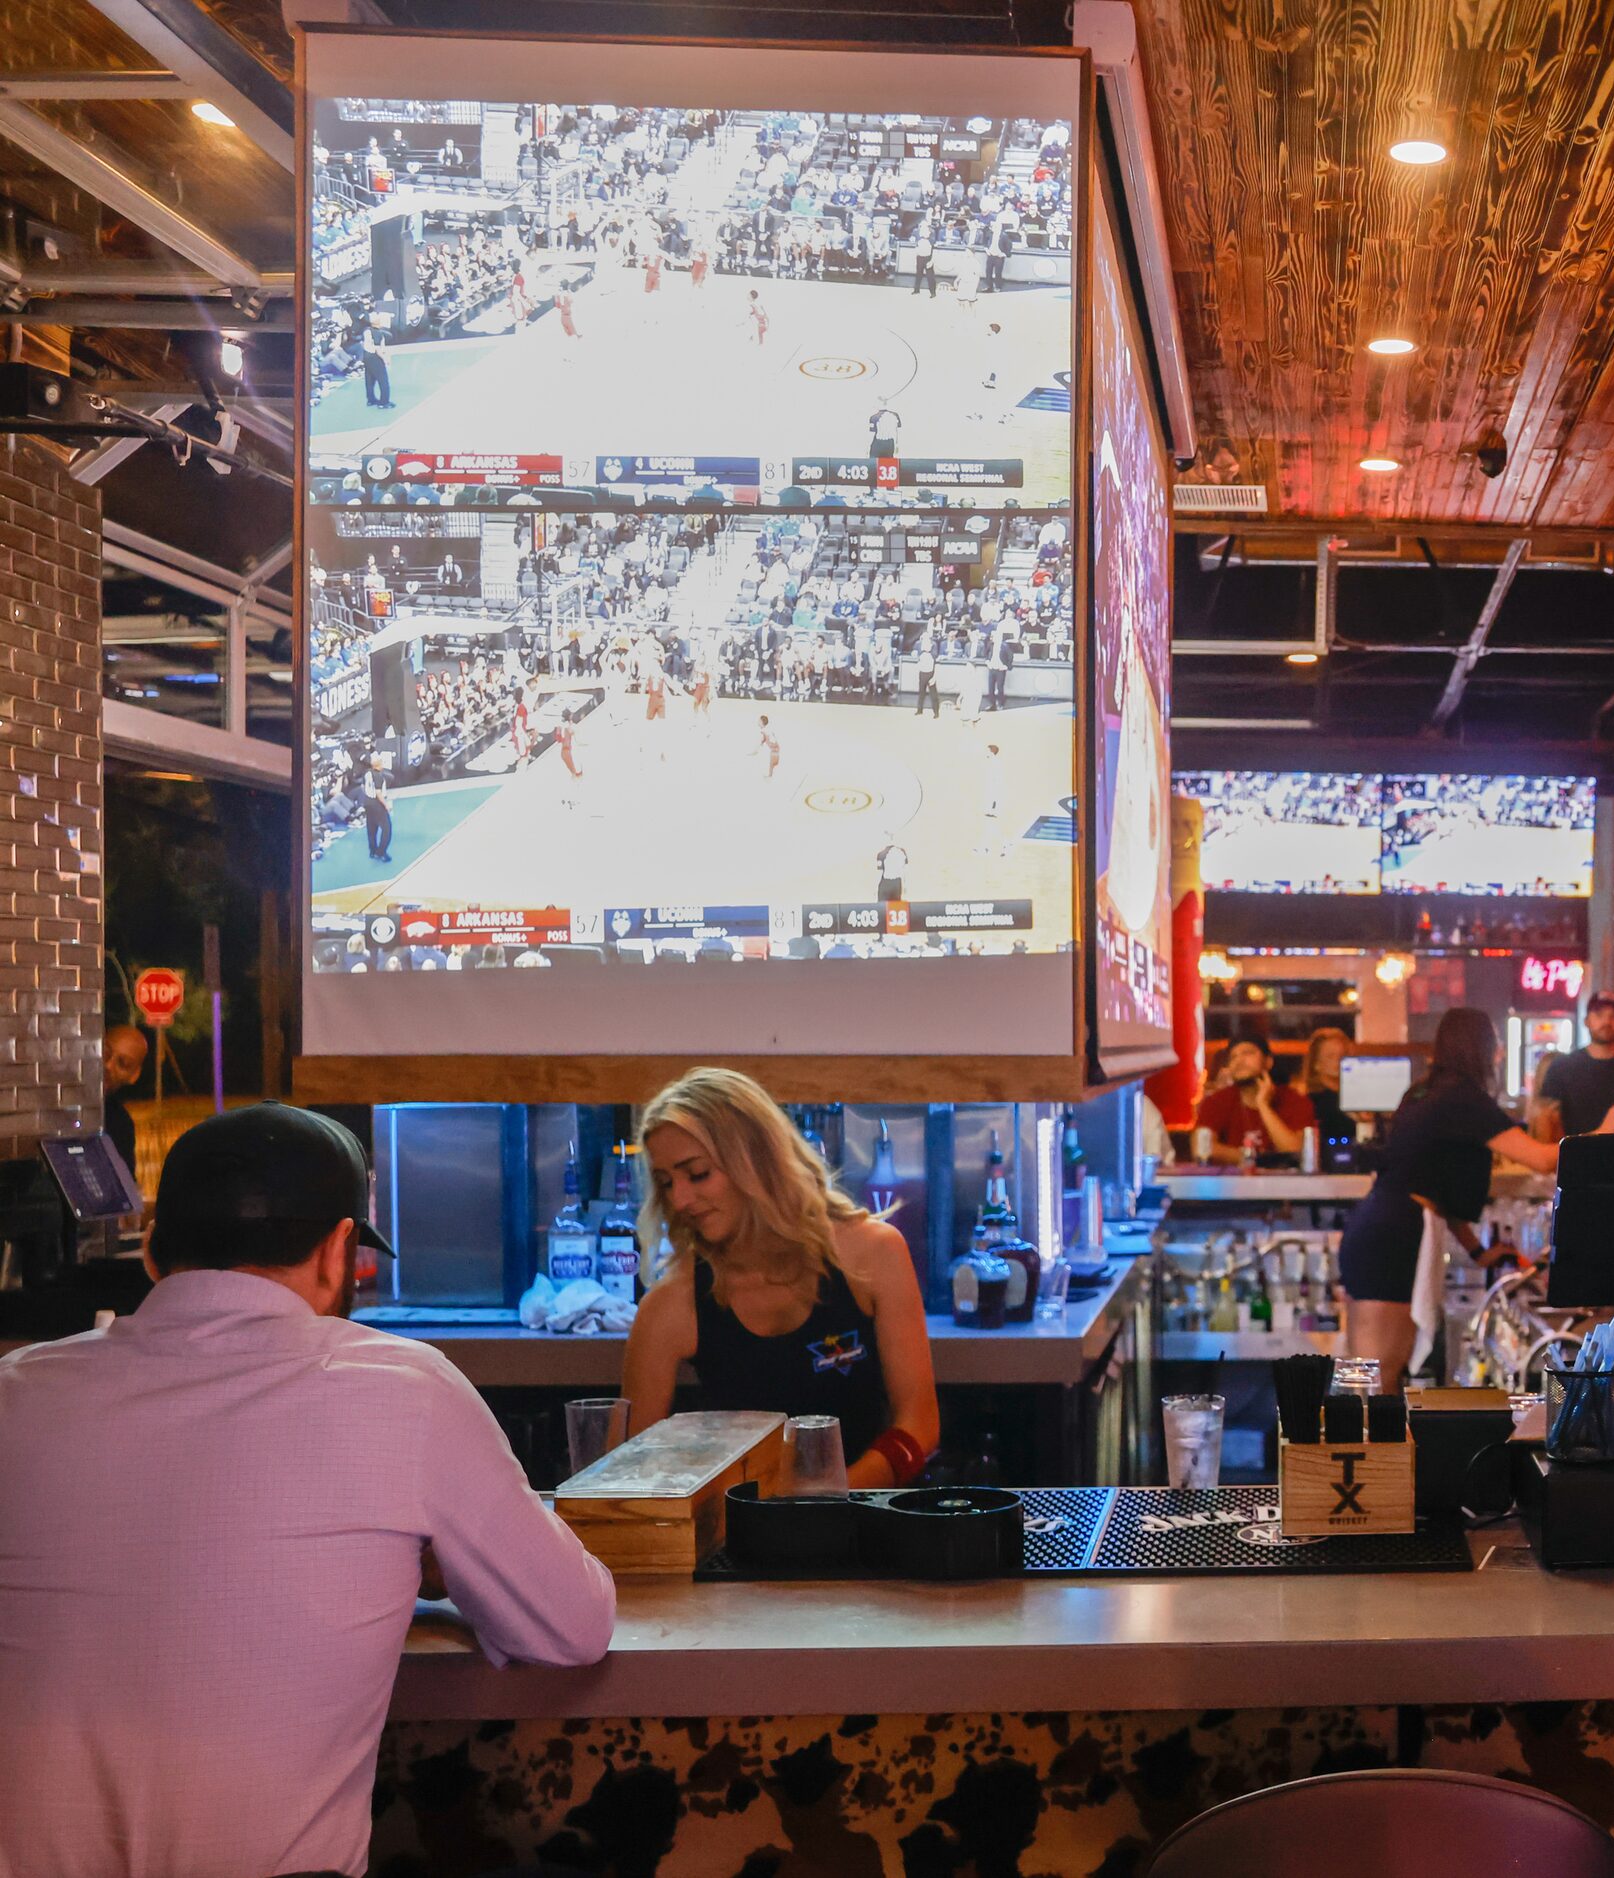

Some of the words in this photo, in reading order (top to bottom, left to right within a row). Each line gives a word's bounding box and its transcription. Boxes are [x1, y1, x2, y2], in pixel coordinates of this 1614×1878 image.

[450, 456, 519, 469] ARKANSAS
[568, 461, 590, 479] 57
[649, 457, 695, 470] UCONN
[961, 463, 985, 473] WEST
[764, 462, 787, 480] 81
[799, 465, 824, 481] 2ND
[837, 464, 869, 481] 4:03
[878, 464, 898, 481] 3.8
[916, 473, 959, 483] REGIONAL
[539, 474, 560, 485] POSS
[456, 912, 524, 927] ARKANSAS
[575, 914, 599, 935] 57
[847, 910, 879, 927] 4:03
[547, 930, 568, 943] POSS
[140, 982, 180, 1004] STOP
[1138, 1510, 1251, 1532] JACK
